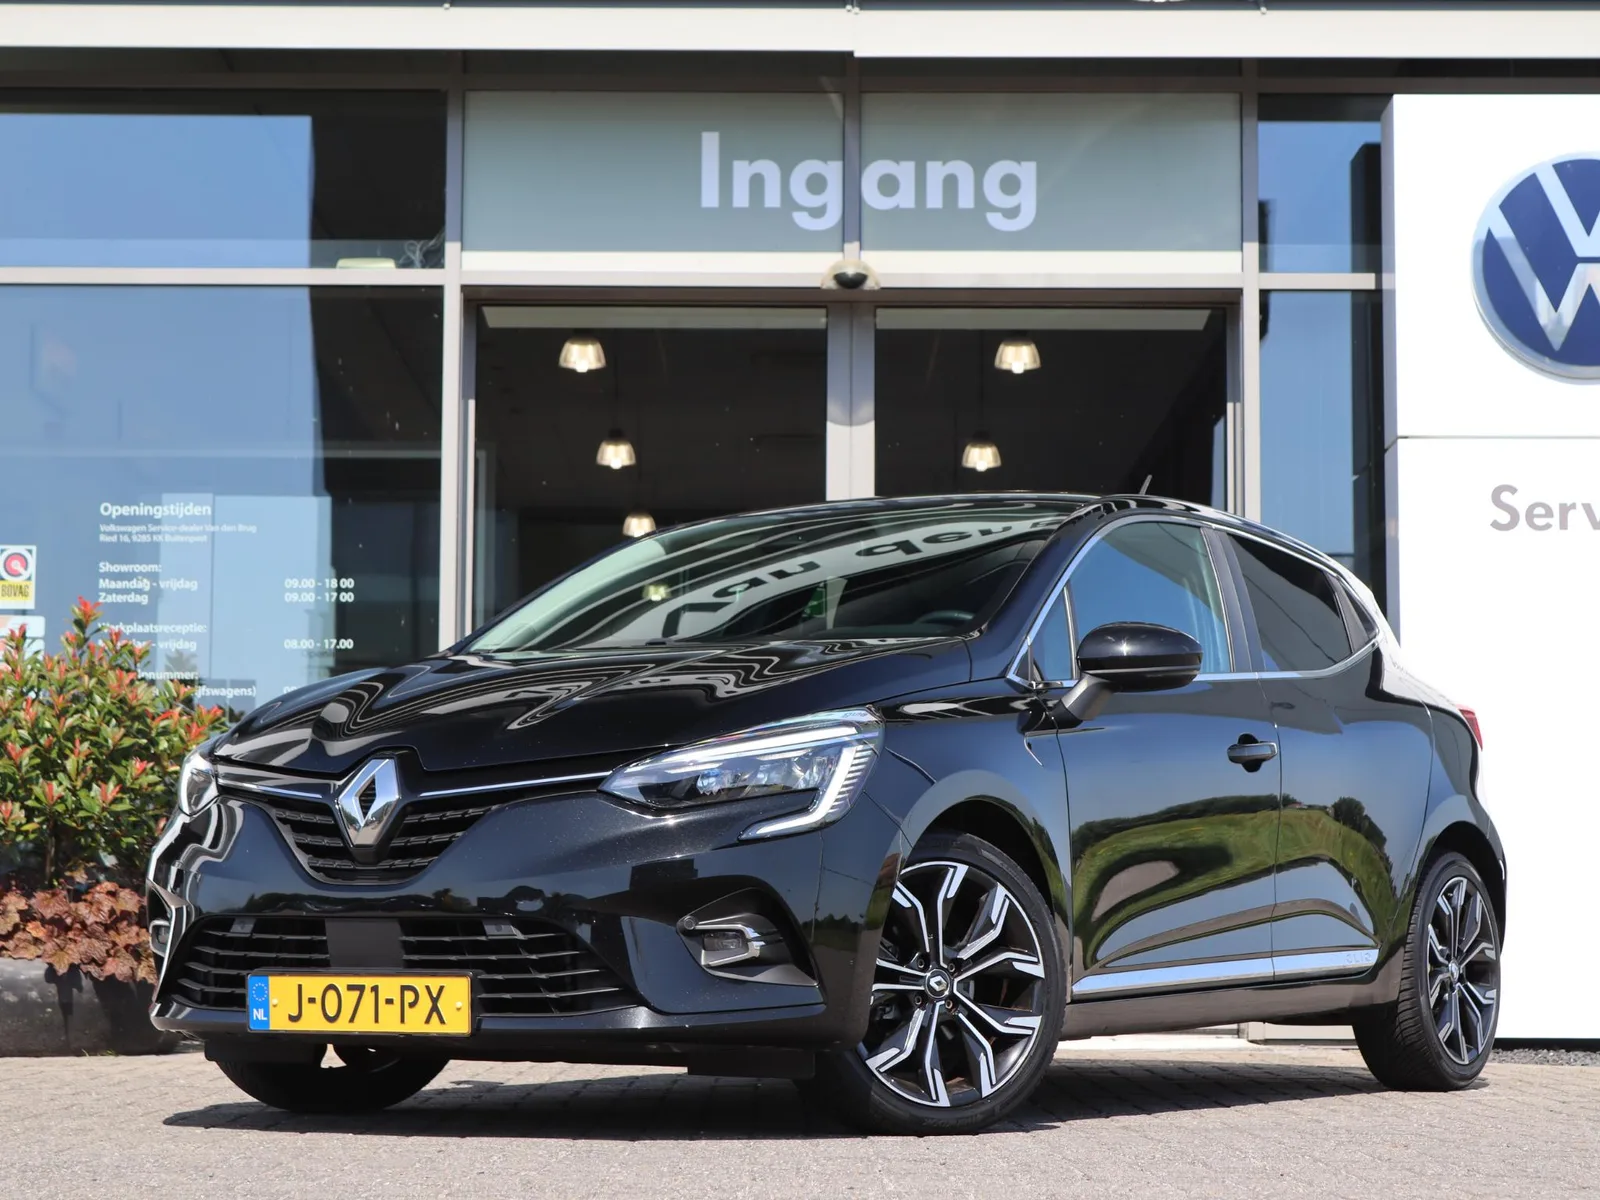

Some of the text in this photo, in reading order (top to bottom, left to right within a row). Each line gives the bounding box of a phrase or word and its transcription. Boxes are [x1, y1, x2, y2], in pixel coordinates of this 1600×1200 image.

[701, 131, 1038, 232] Ingang
[100, 502, 212, 518] Openingstijden
[100, 524, 147, 535] Volkswagen
[98, 562, 162, 573] Showroom:
[98, 578, 150, 591] Maandag
[159, 579, 198, 591] vrijdag
[284, 578, 315, 588] 09.00
[1, 584, 30, 598] BOVAG
[284, 592, 315, 602] 09.00
[98, 592, 149, 605] Zaterdag
[157, 639, 197, 651] vrijdag
[284, 639, 314, 649] 08.00
[324, 639, 354, 649] 17.00
[288, 984, 447, 1025] J-071-PX
[253, 1009, 267, 1020] NL
